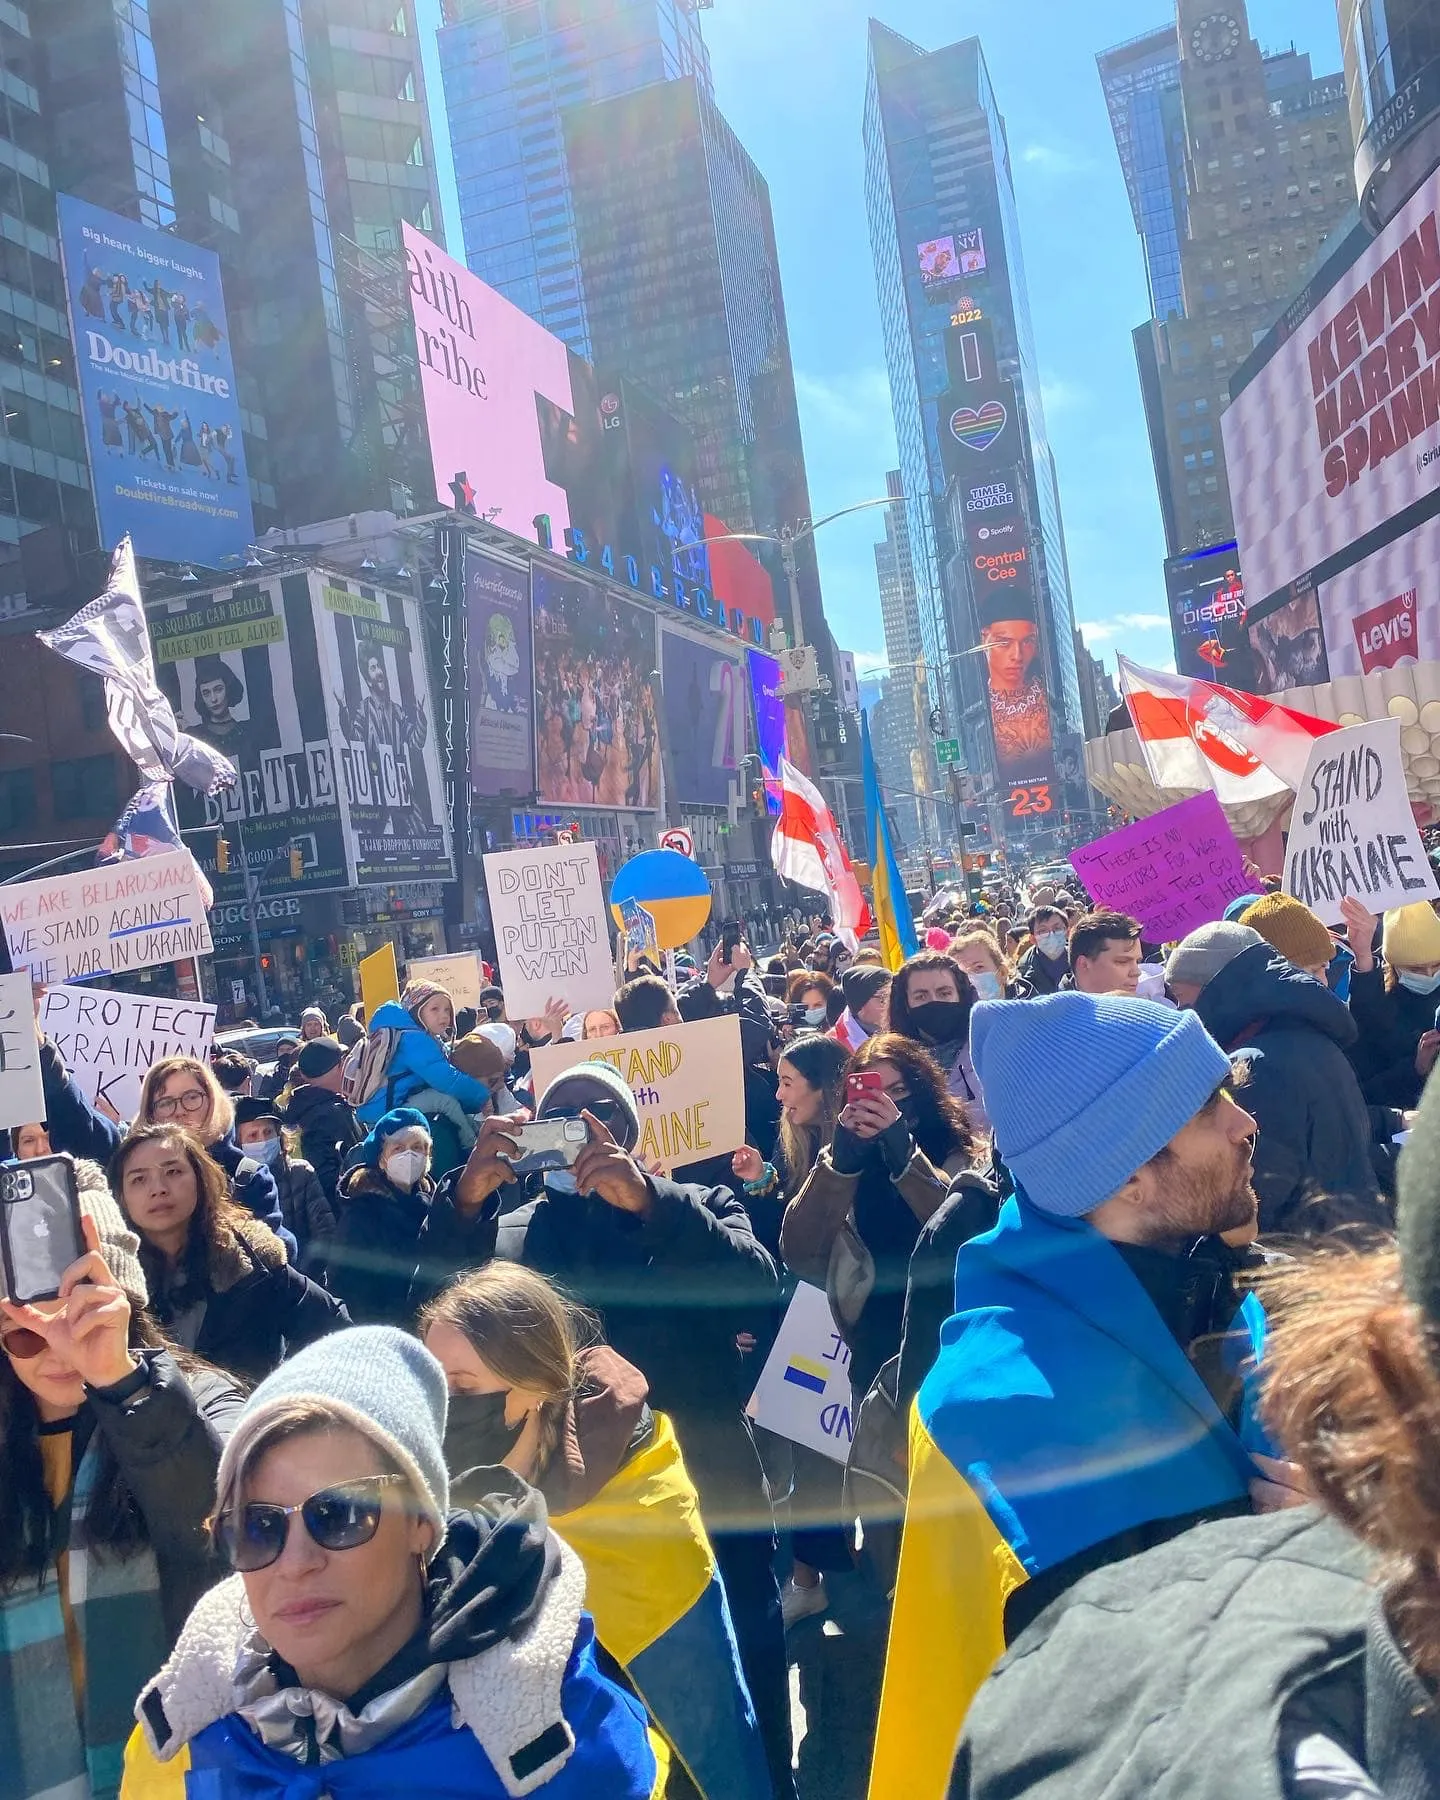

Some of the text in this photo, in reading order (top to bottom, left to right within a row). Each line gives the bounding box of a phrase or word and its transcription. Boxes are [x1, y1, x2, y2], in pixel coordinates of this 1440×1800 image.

[82, 226, 206, 280] Big heart, bigger laughs.
[950, 308, 982, 326] 2022
[1307, 210, 1440, 399] KEVIN
[85, 330, 230, 399] Doubtfire
[604, 416, 620, 429] LG
[115, 485, 239, 519] DoubtfireBroadway.com
[134, 475, 219, 501] Tickets on sale now!
[967, 493, 1013, 511] SQUARE
[970, 483, 1006, 500] TIMES
[990, 525, 1014, 536] Spotify
[534, 513, 639, 587] 1540
[975, 547, 1026, 569] Central
[987, 567, 1017, 581] Cee
[165, 612, 203, 633] SQUARE
[206, 605, 226, 622] CAN
[229, 595, 266, 618] REALLY
[161, 621, 280, 658] MAKE YOU FEEL ALIVE!
[838, 713, 847, 744] 1500
[1010, 785, 1053, 816] 23
[1302, 744, 1384, 826] STAND
[1319, 809, 1358, 847] with
[247, 848, 274, 864] GOOD
[1290, 834, 1428, 909] UKRAINE
[499, 857, 590, 895] DON'T
[3, 899, 34, 924] WE
[38, 888, 73, 917] ARE
[82, 864, 196, 909] BELARUSIANS
[518, 888, 576, 922] LET
[9, 893, 191, 957] WE STAND AGAINST
[211, 898, 301, 925] UGGAGE
[413, 910, 430, 918] SONY
[213, 935, 242, 946] SONY
[501, 916, 599, 955] PUTIN
[31, 922, 212, 985] HE WAR IN UKRAINE
[515, 947, 589, 982] WIN
[44, 992, 215, 1040] PROTECT
[631, 1086, 660, 1107] ith
